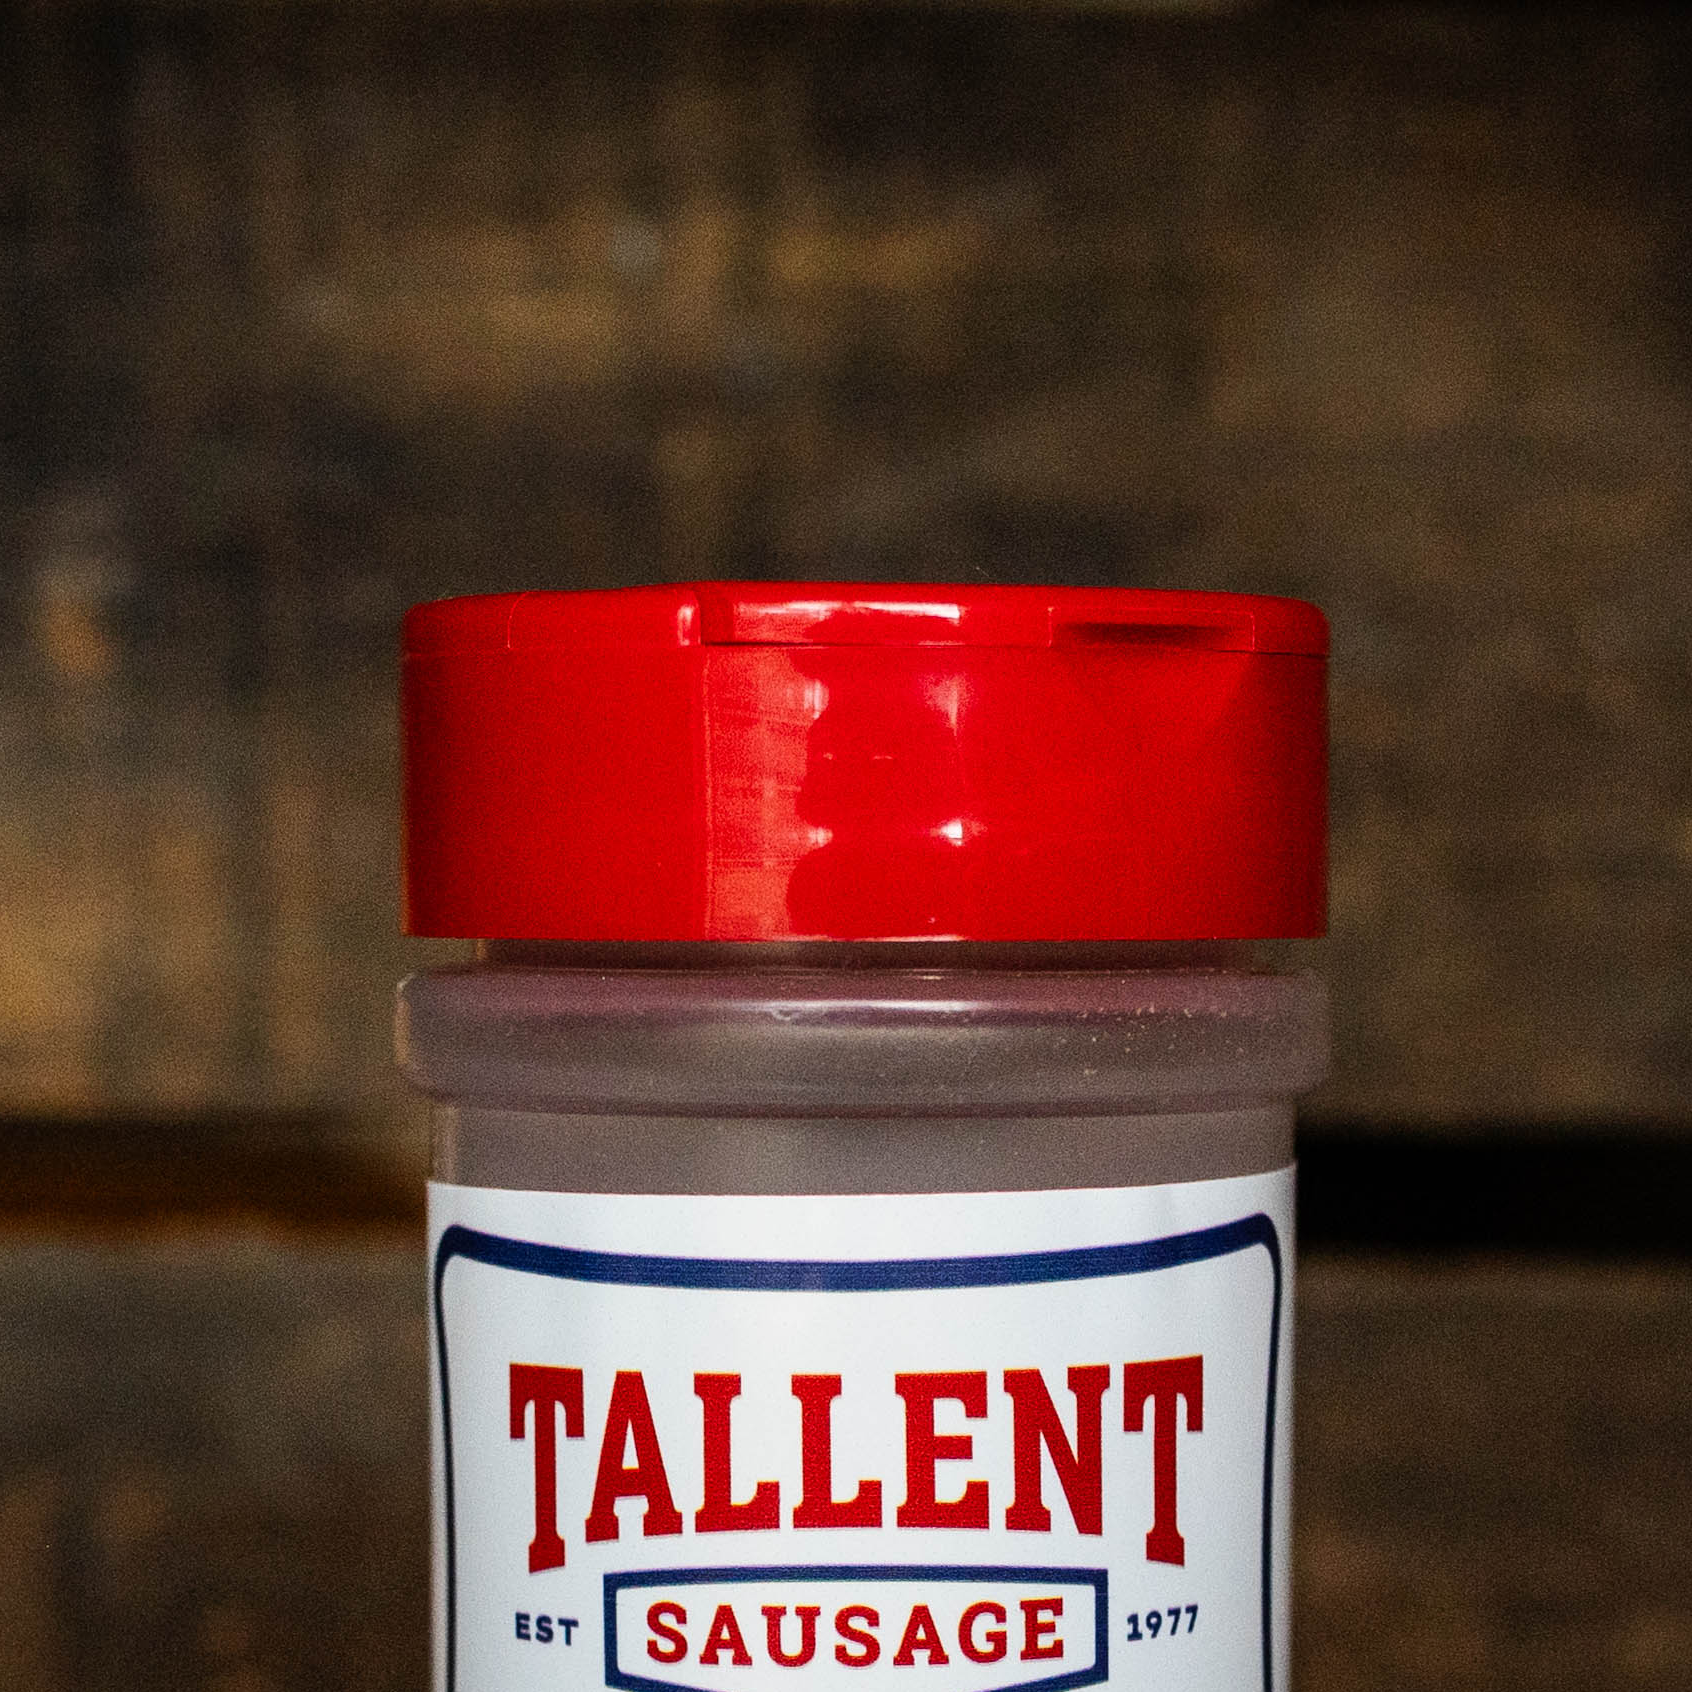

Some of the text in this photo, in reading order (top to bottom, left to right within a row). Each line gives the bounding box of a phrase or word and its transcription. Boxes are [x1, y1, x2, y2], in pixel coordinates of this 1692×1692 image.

[509, 1354, 1203, 1574] TALLENT
[515, 1612, 578, 1645] EST
[647, 1597, 1065, 1668] SAUSAGE
[1127, 1604, 1198, 1641] 1977
